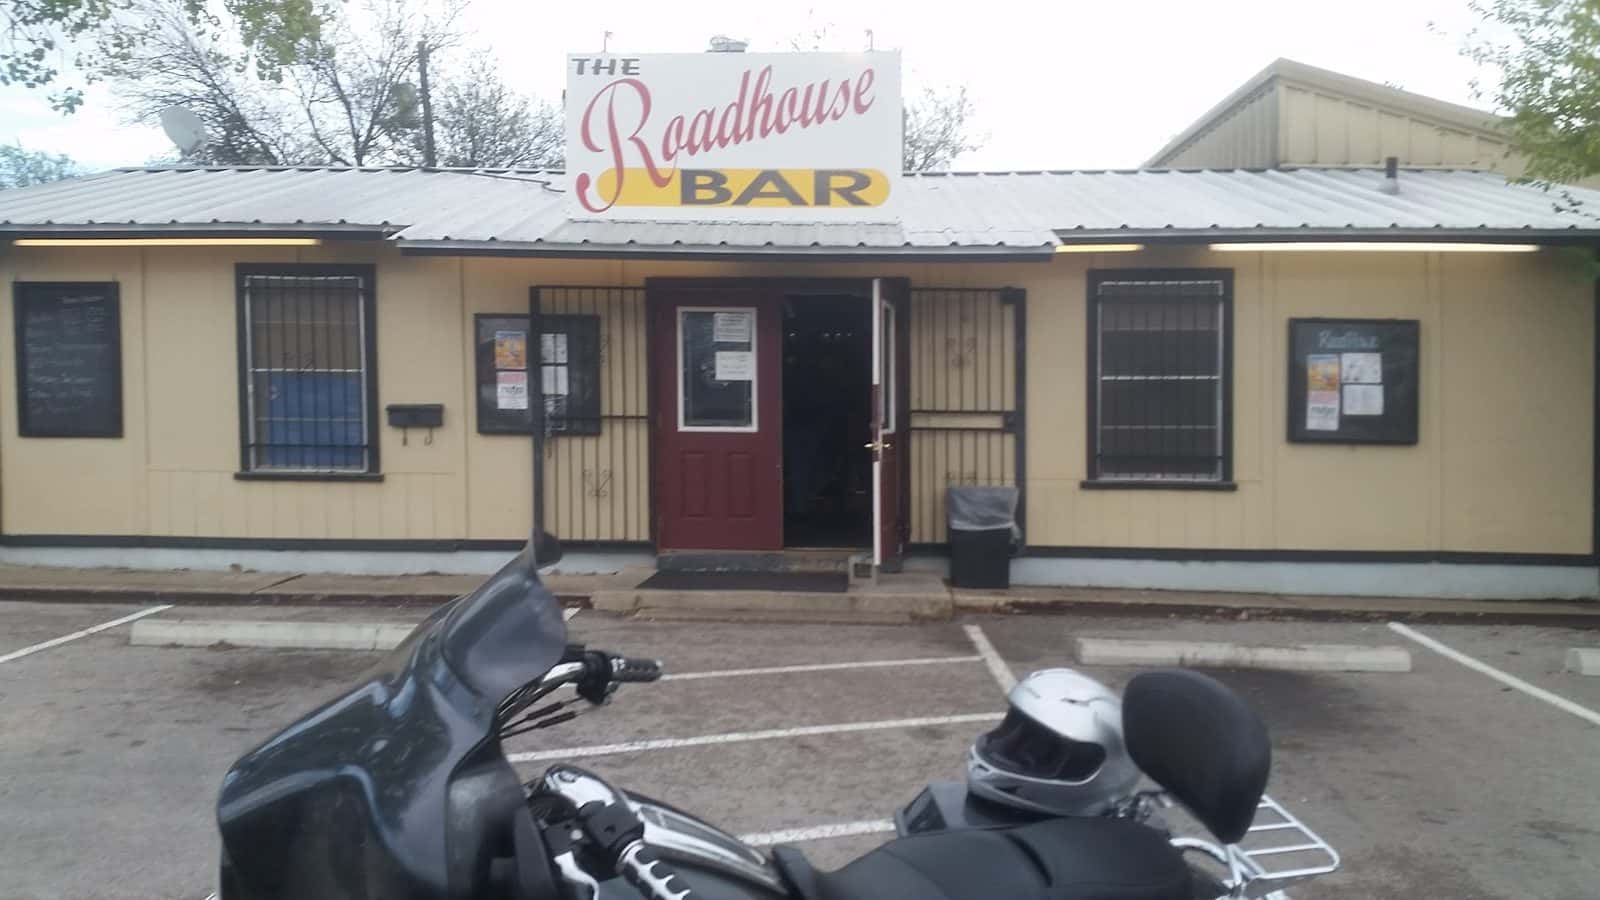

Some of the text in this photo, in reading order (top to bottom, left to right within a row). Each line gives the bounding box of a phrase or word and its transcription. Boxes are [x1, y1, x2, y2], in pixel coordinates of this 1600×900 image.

[572, 58, 640, 75] THE
[576, 65, 875, 213] Roadhouse
[680, 170, 872, 206] BAR
